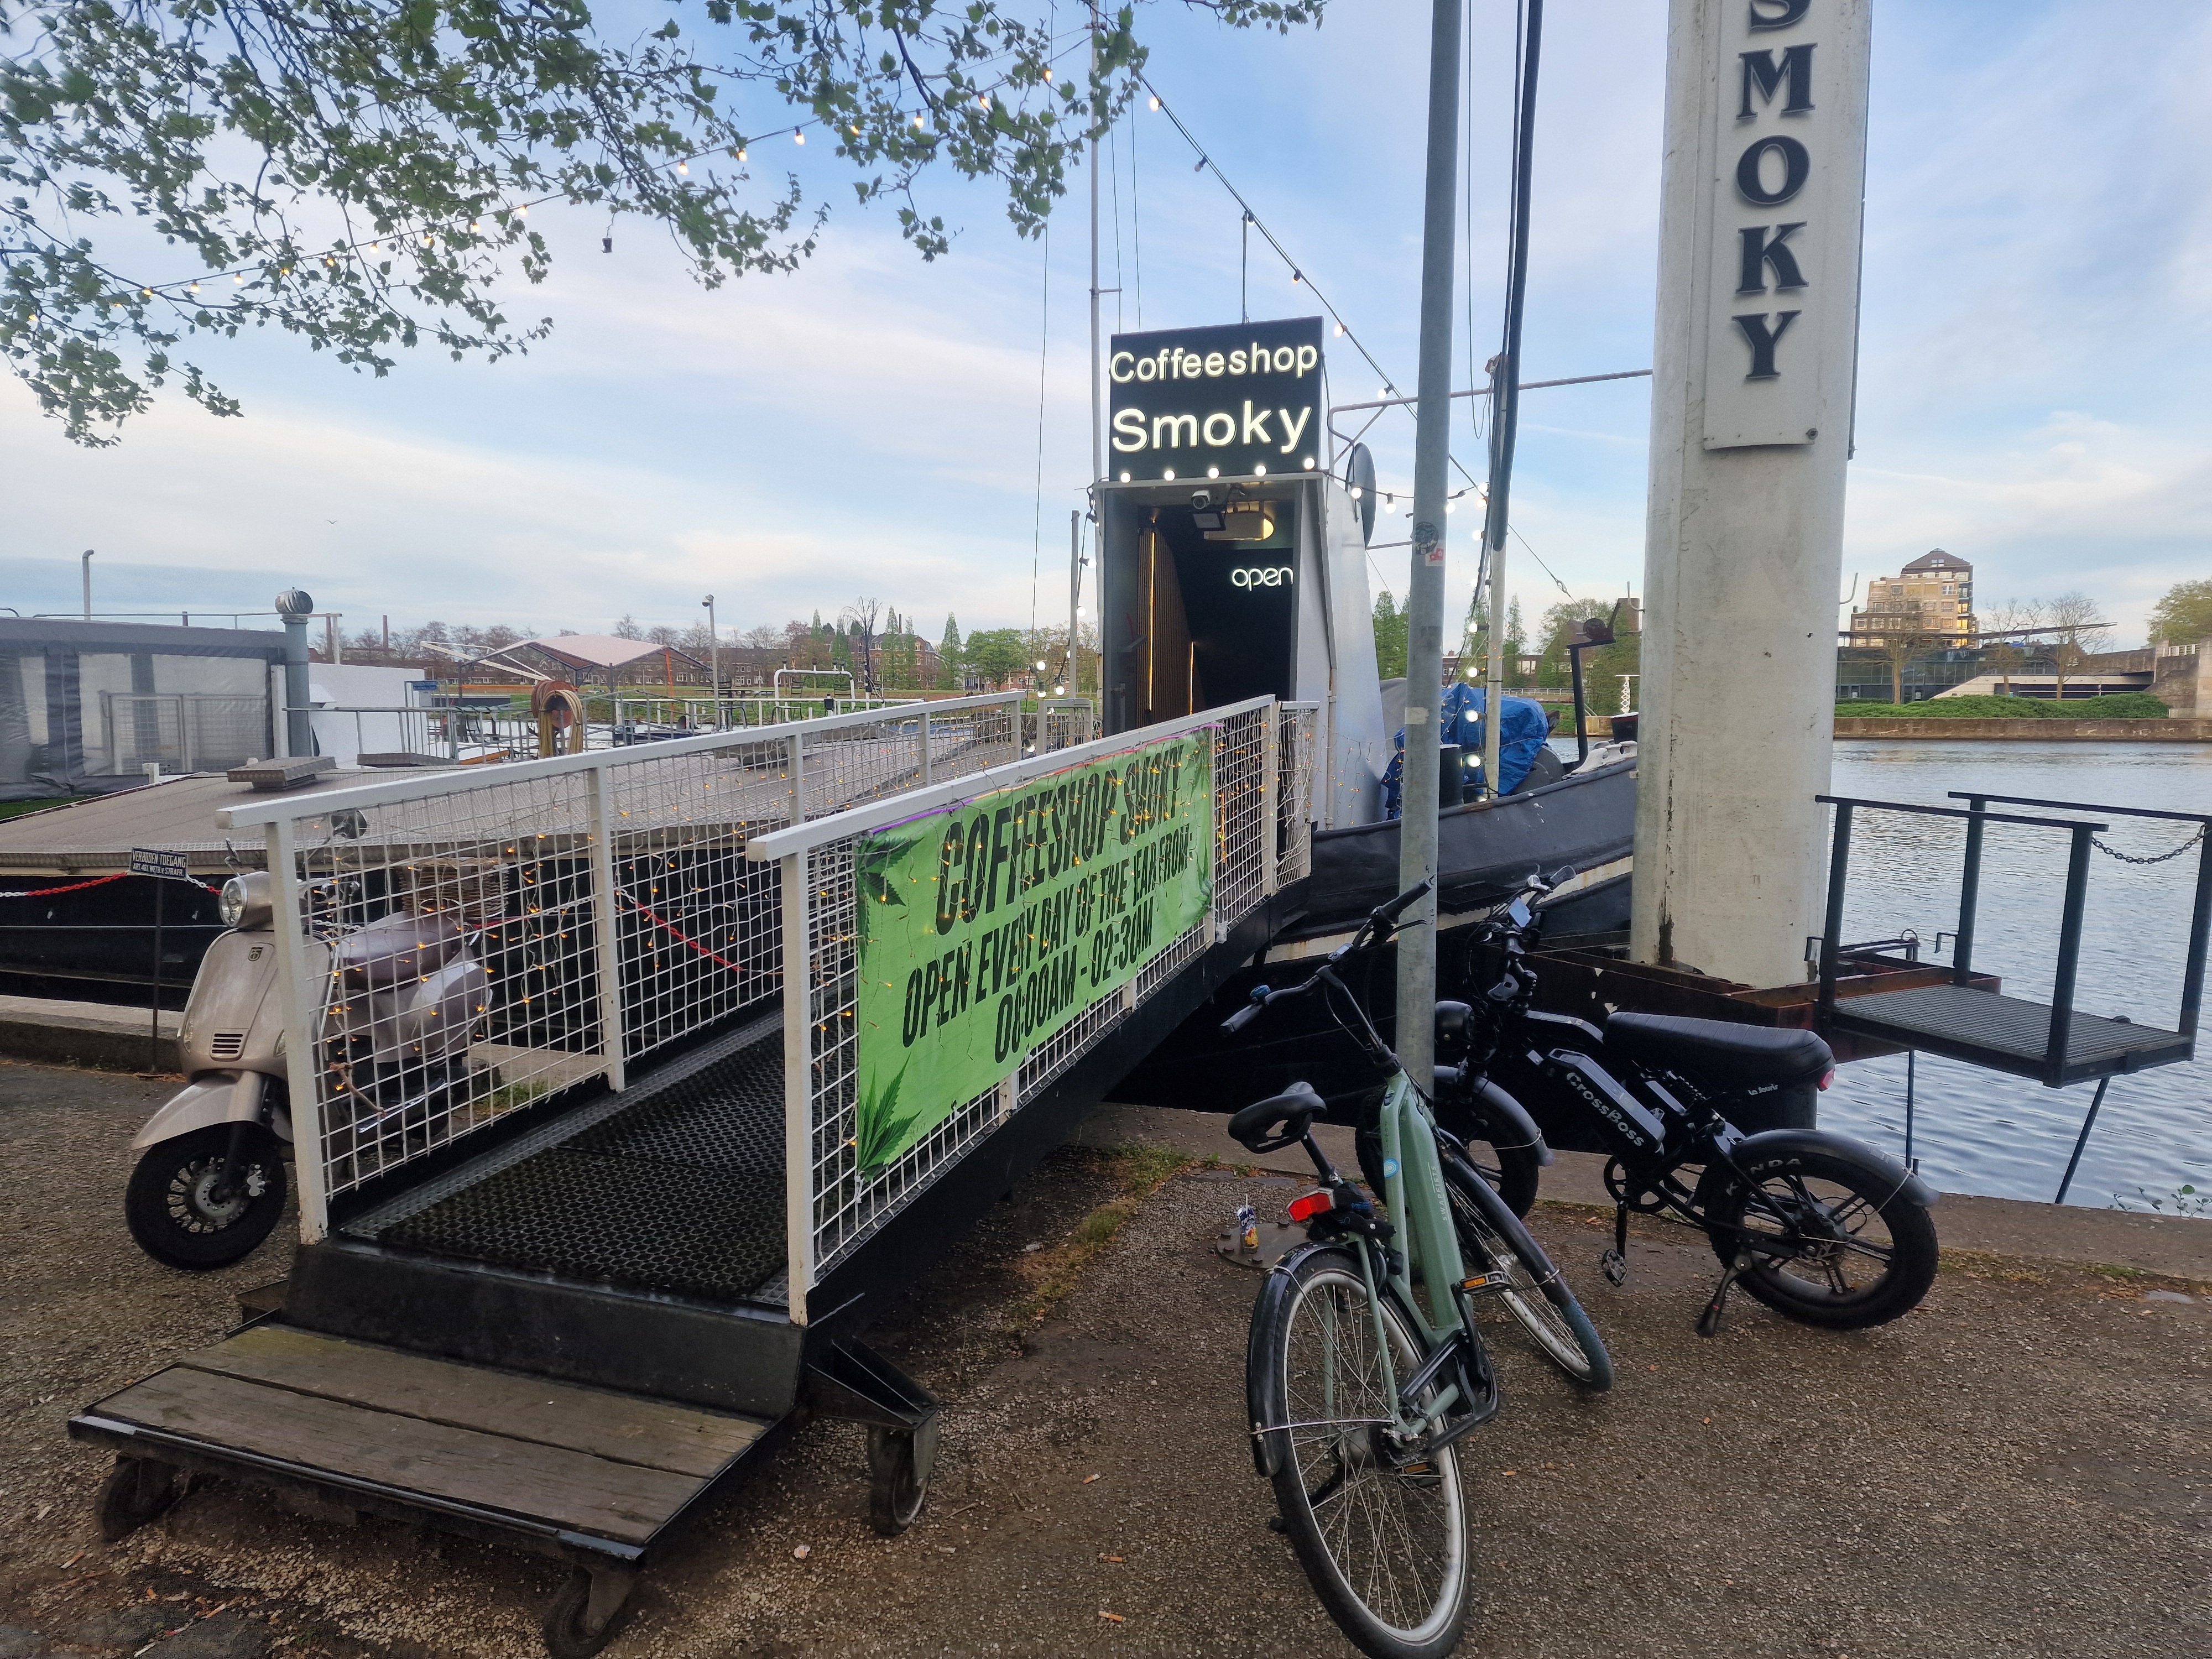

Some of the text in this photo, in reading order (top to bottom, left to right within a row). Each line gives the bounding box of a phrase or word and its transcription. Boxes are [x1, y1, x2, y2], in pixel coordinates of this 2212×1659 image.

[1110, 342, 1319, 383] Coffeeshop
[1112, 400, 1312, 454] Smoky
[1232, 567, 1293, 591] open
[133, 851, 186, 868] VERBODEN TOEGANG
[936, 744, 1184, 935] COFFEESHOP SMOKY
[902, 941, 972, 1048] OPEN
[975, 903, 1037, 1004] EVERY
[1038, 884, 1074, 962] DAY
[1075, 872, 1097, 937] OF
[1099, 859, 1129, 924] THE
[995, 896, 1154, 1063] 08:00AM - 02:30AM
[1566, 1072, 1645, 1146] CrossBoss
[1431, 1166, 1448, 1221] SWAPFIETS
